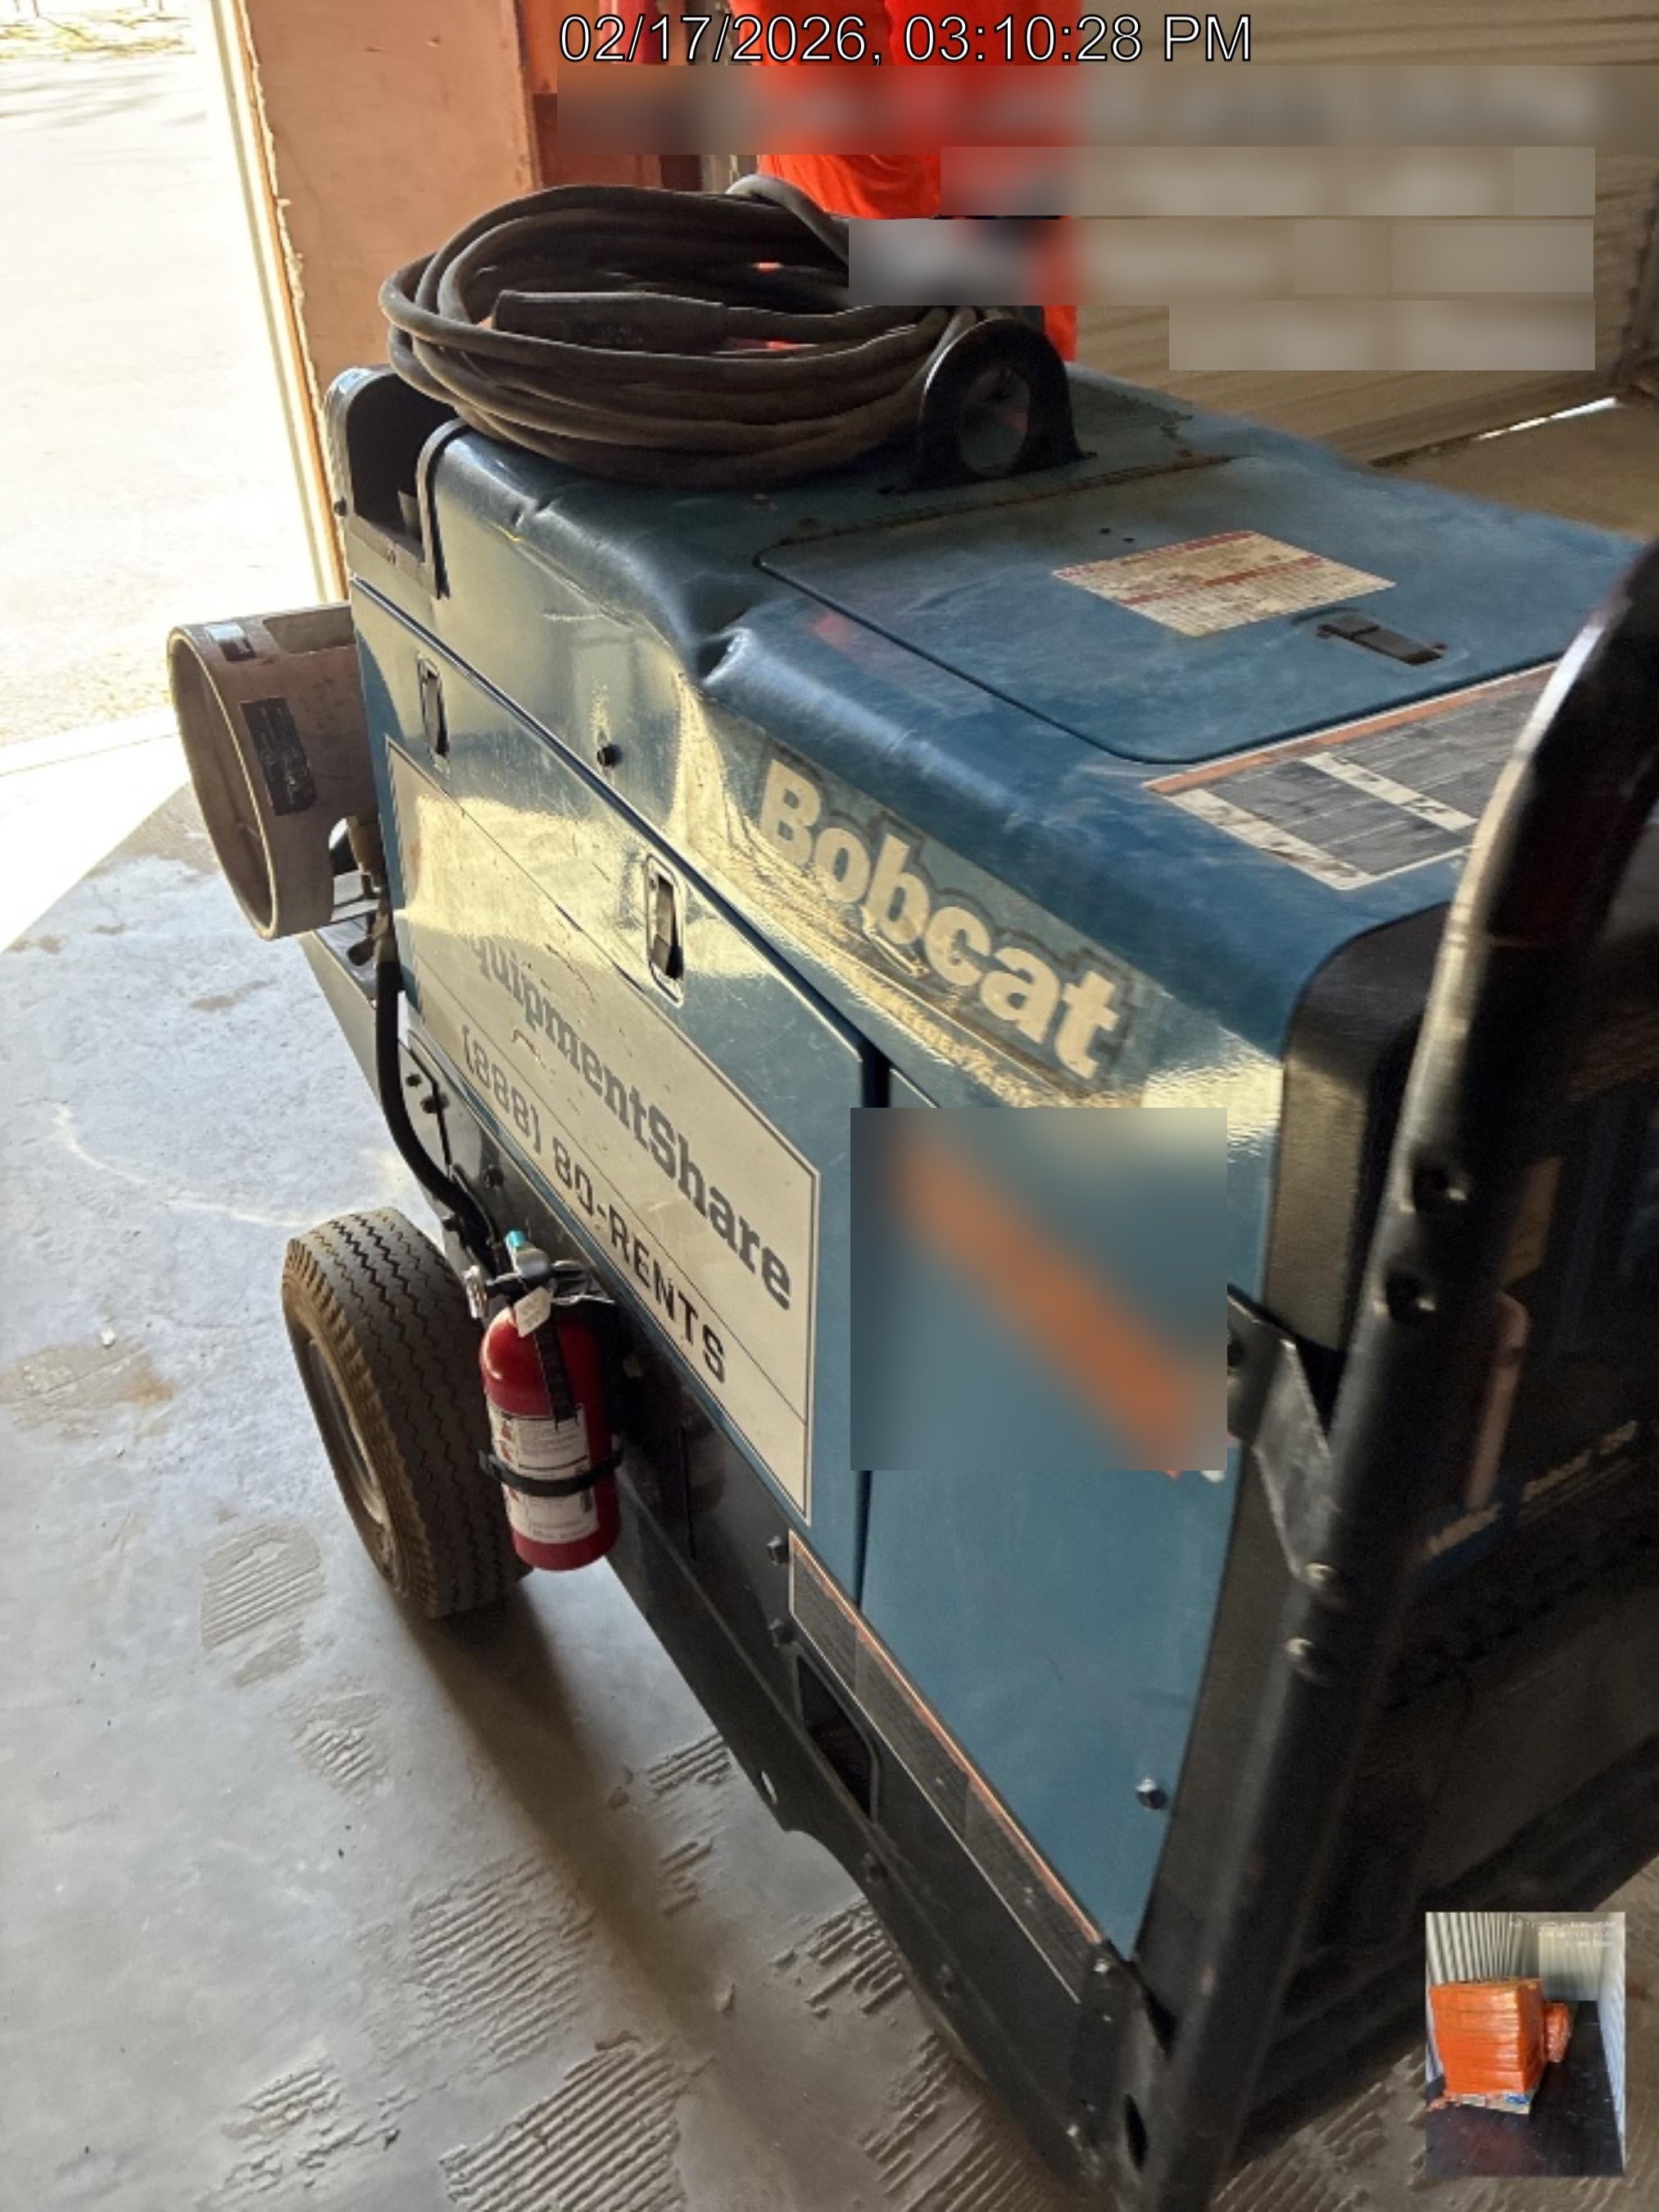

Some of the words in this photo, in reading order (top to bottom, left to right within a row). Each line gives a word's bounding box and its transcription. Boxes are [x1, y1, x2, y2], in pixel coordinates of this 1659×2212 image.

[759, 758, 1122, 1081] Bobcat
[461, 1024, 542, 1155] (888)
[552, 1136, 725, 1385] 80-RENTS
[464, 936, 792, 1311] quipmentShare
